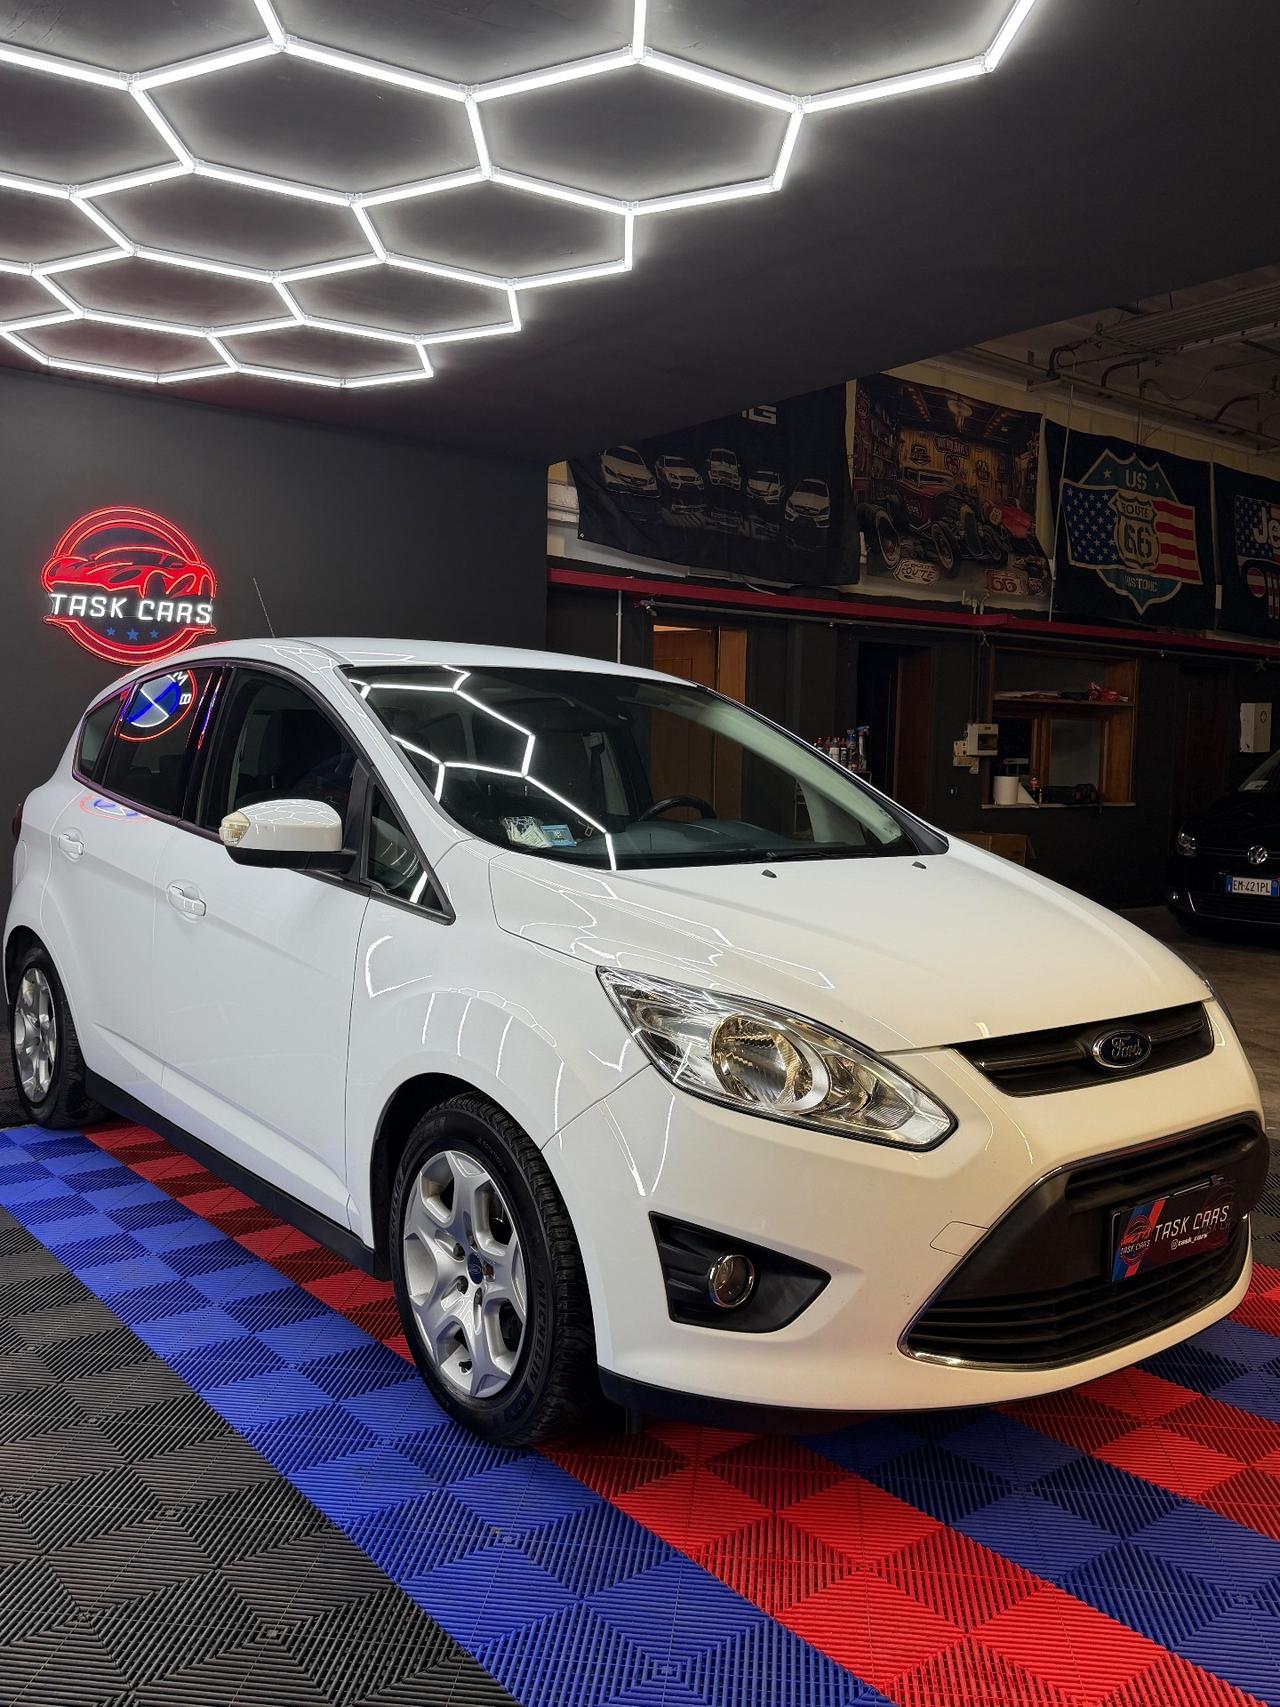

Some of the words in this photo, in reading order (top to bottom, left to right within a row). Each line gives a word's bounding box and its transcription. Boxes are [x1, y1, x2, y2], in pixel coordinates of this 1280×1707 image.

[1125, 469, 1148, 490] US
[1121, 502, 1149, 518] ROUTE
[1124, 522, 1152, 559] 66
[50, 593, 128, 619] TASK
[137, 599, 213, 624] CARS
[1111, 1035, 1143, 1058] Ford
[1155, 1215, 1191, 1242] TASK
[1193, 1205, 1230, 1231] CARS
[529, 1279, 547, 1385] MICHELIN
